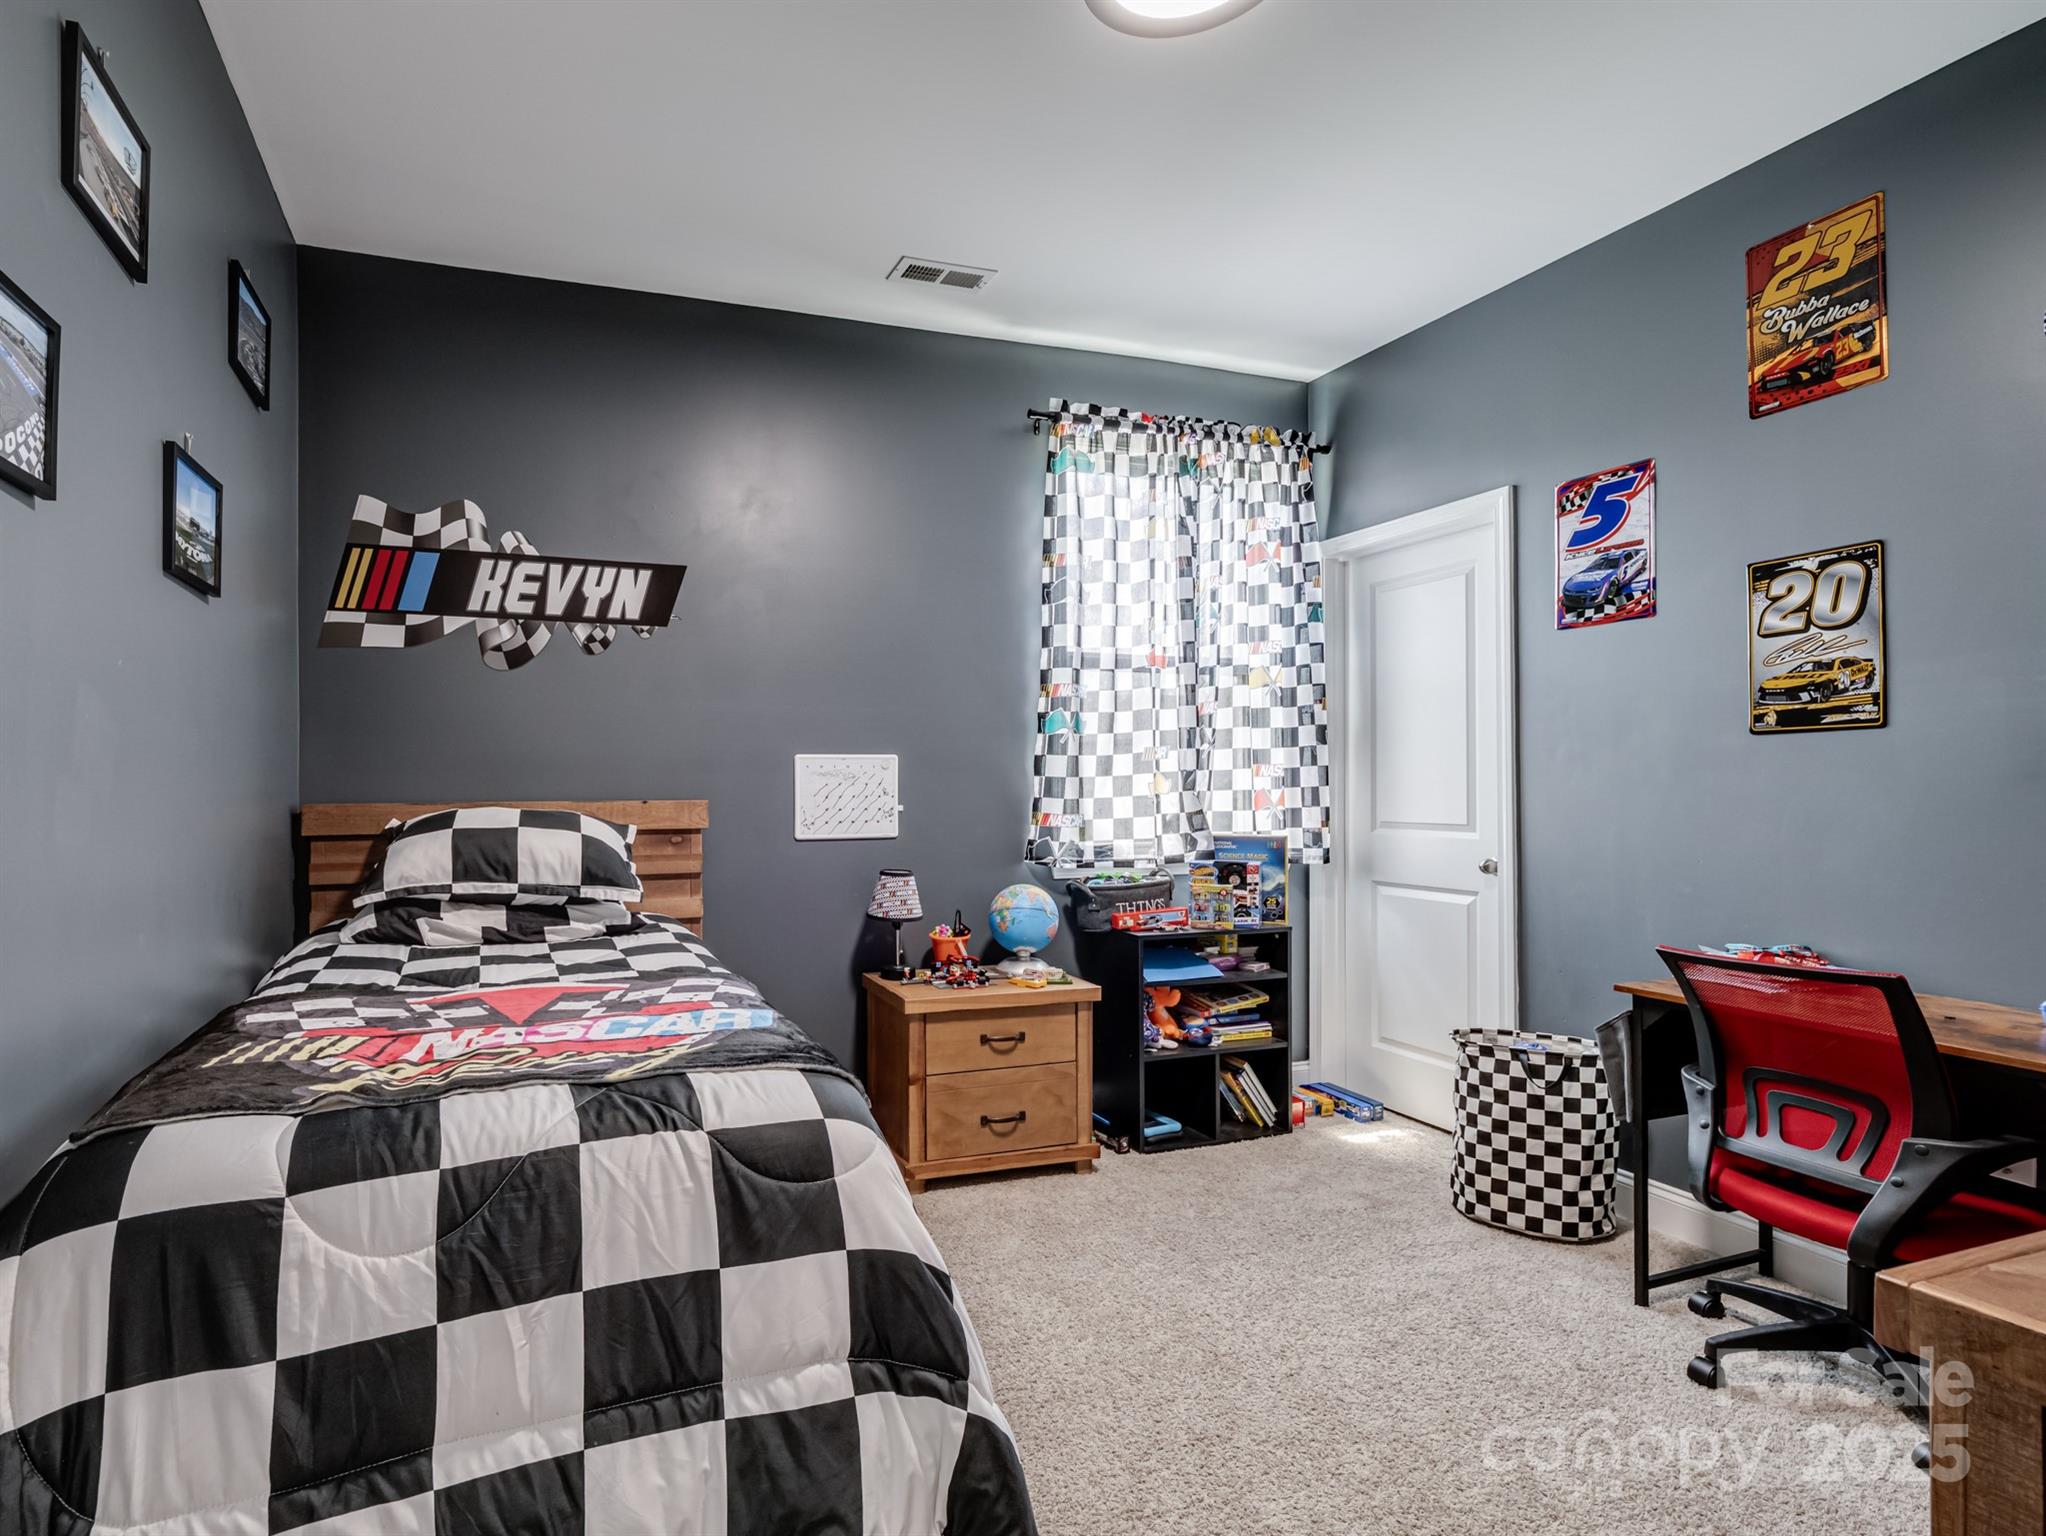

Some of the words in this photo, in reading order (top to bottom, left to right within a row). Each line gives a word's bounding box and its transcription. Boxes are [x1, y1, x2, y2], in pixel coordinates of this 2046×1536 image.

[1755, 209, 1873, 311] 23
[1760, 293, 1831, 335] Bubba
[1781, 297, 1870, 344] Wallace
[1836, 339, 1850, 359] 23
[1566, 471, 1646, 552] 5
[465, 557, 654, 621] KEVYN
[1758, 560, 1867, 637] 20
[1839, 671, 1851, 690] 20
[403, 1009, 757, 1062] NASCAR
